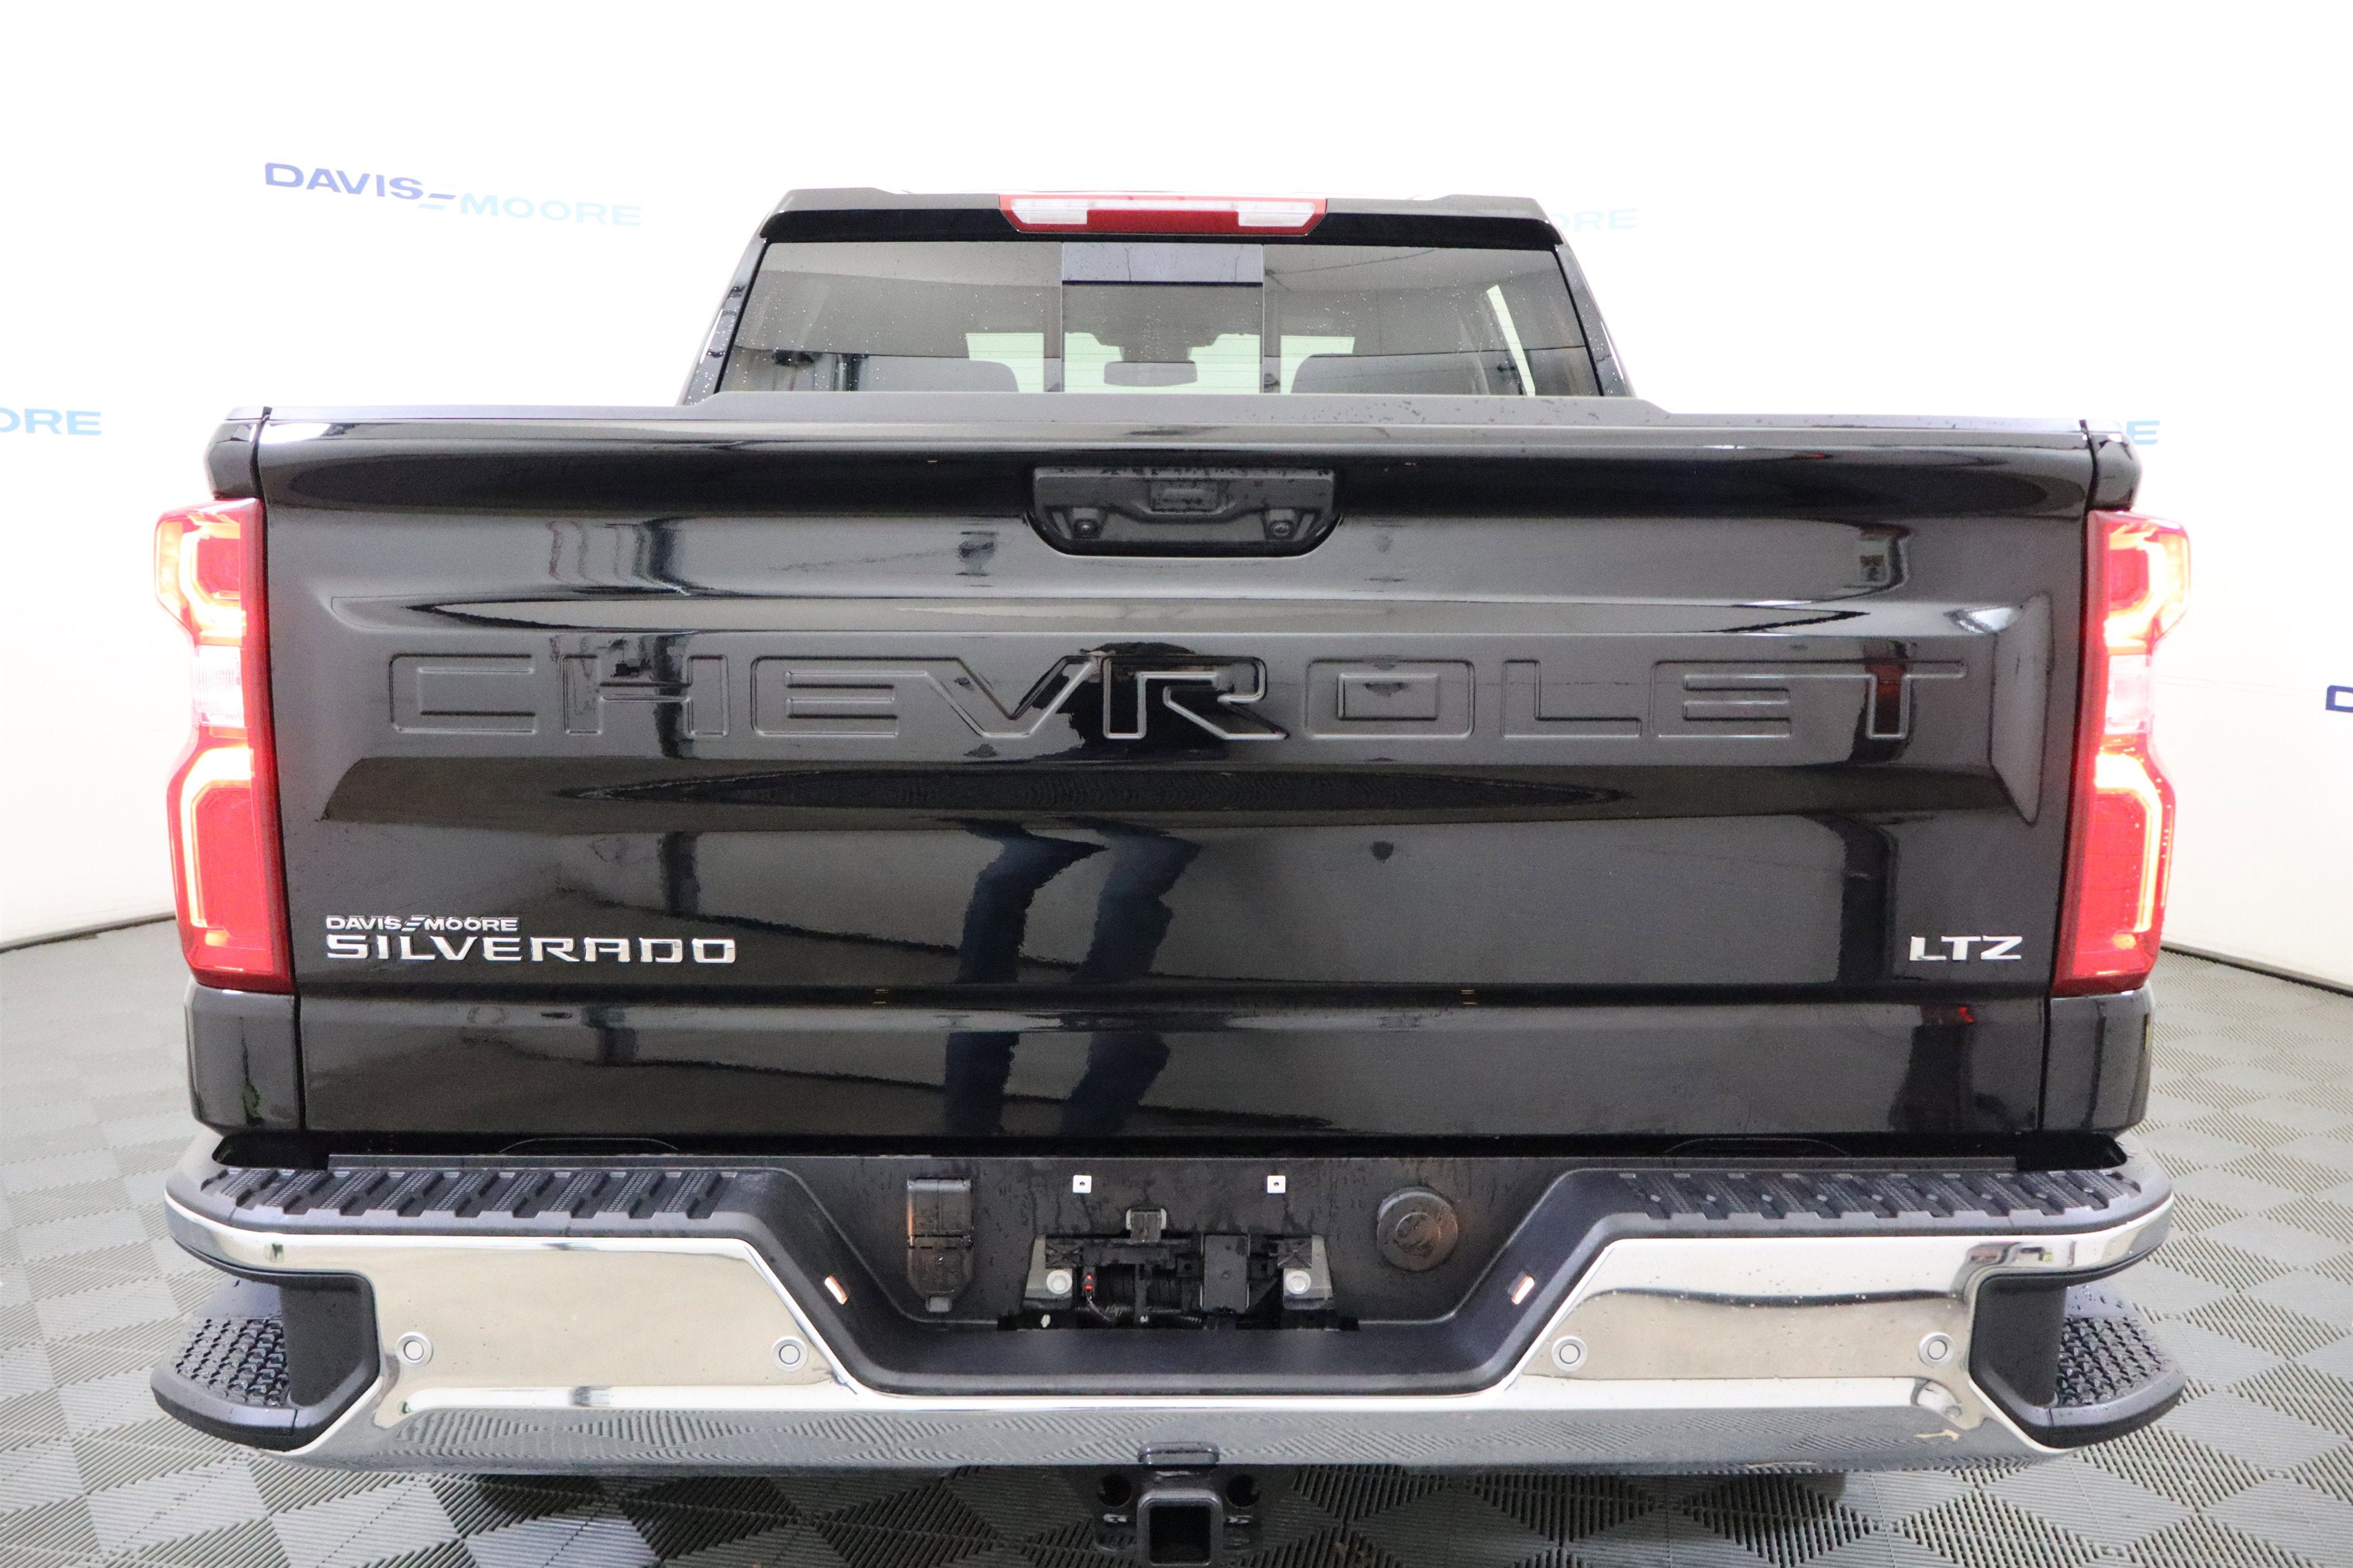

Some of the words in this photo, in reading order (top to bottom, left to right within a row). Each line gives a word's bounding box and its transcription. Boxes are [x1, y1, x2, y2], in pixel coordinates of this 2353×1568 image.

[388, 651, 1968, 742] CHEVROLET
[326, 934, 736, 963] SILVERADO
[1910, 936, 2023, 961] LTZ
